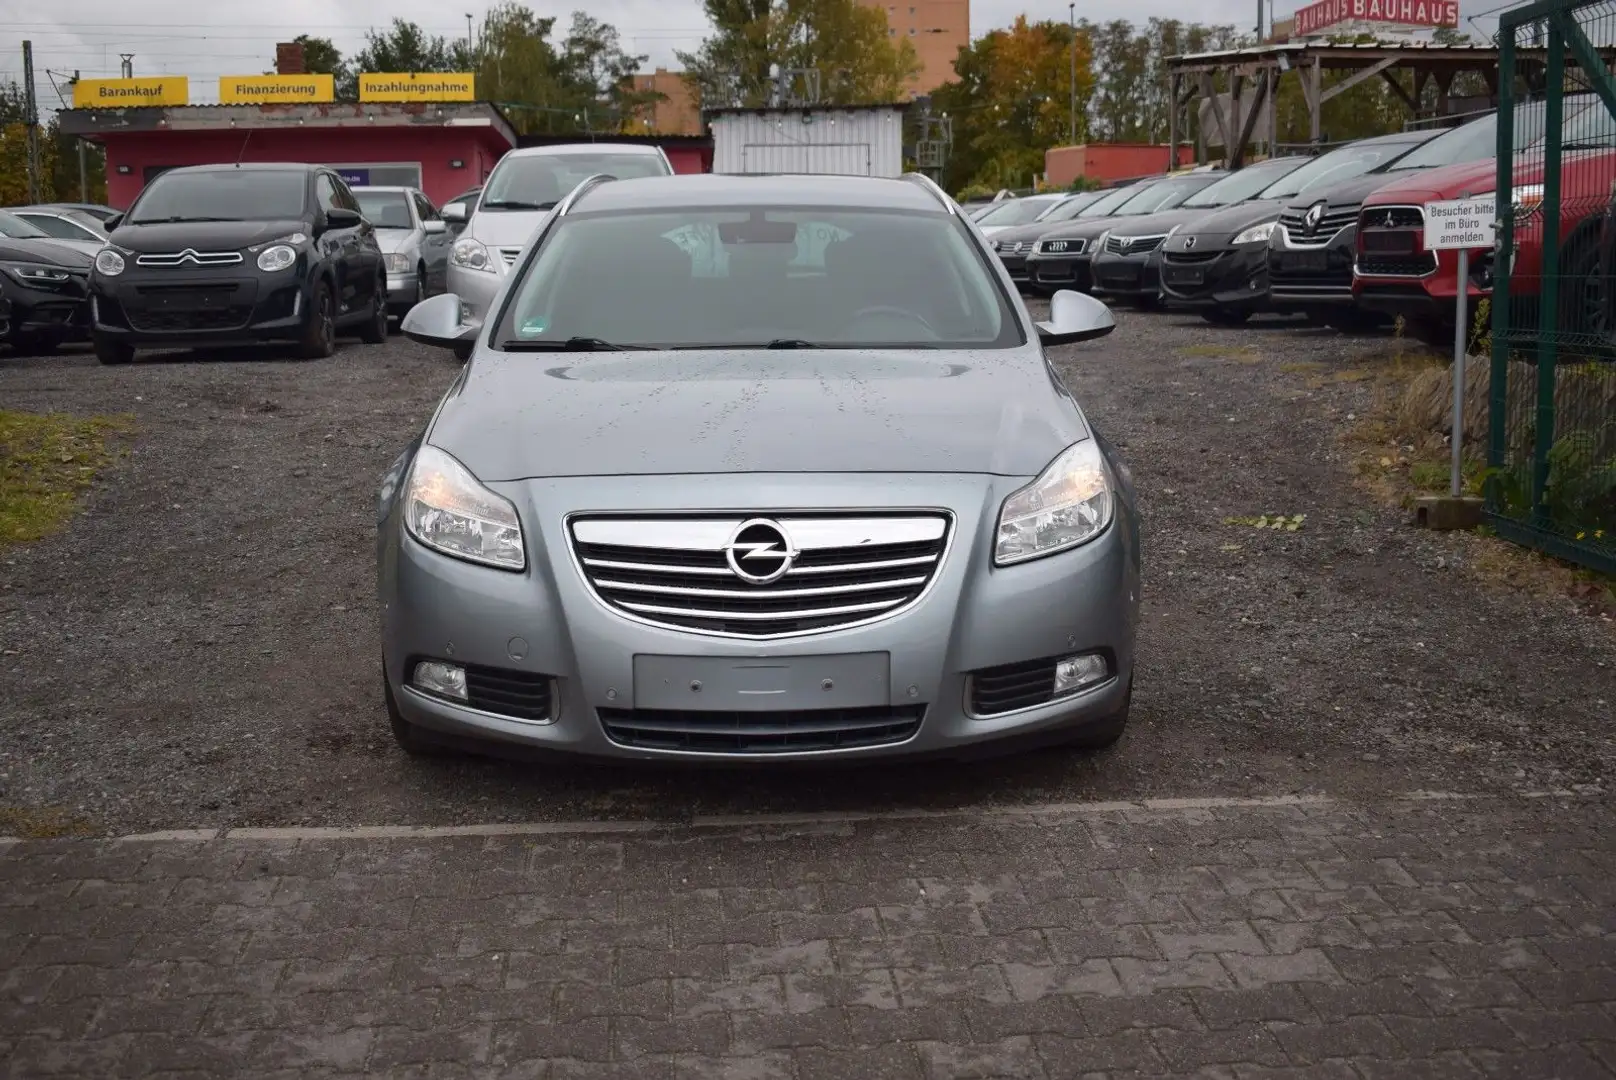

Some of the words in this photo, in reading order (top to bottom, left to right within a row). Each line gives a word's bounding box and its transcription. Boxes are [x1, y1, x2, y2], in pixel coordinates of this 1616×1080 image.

[1296, 1, 1348, 33] BAUHAUS
[1353, 0, 1456, 24] BAUHAUS
[99, 84, 163, 97] Barankauf
[236, 83, 316, 95] Finanzierung
[365, 81, 468, 93] Inzahlungnahme
[1431, 205, 1472, 217] Besucher
[1475, 204, 1494, 214] bitte
[1445, 220, 1456, 230] im
[1458, 218, 1480, 229] Büro
[1440, 232, 1484, 244] anmelden
